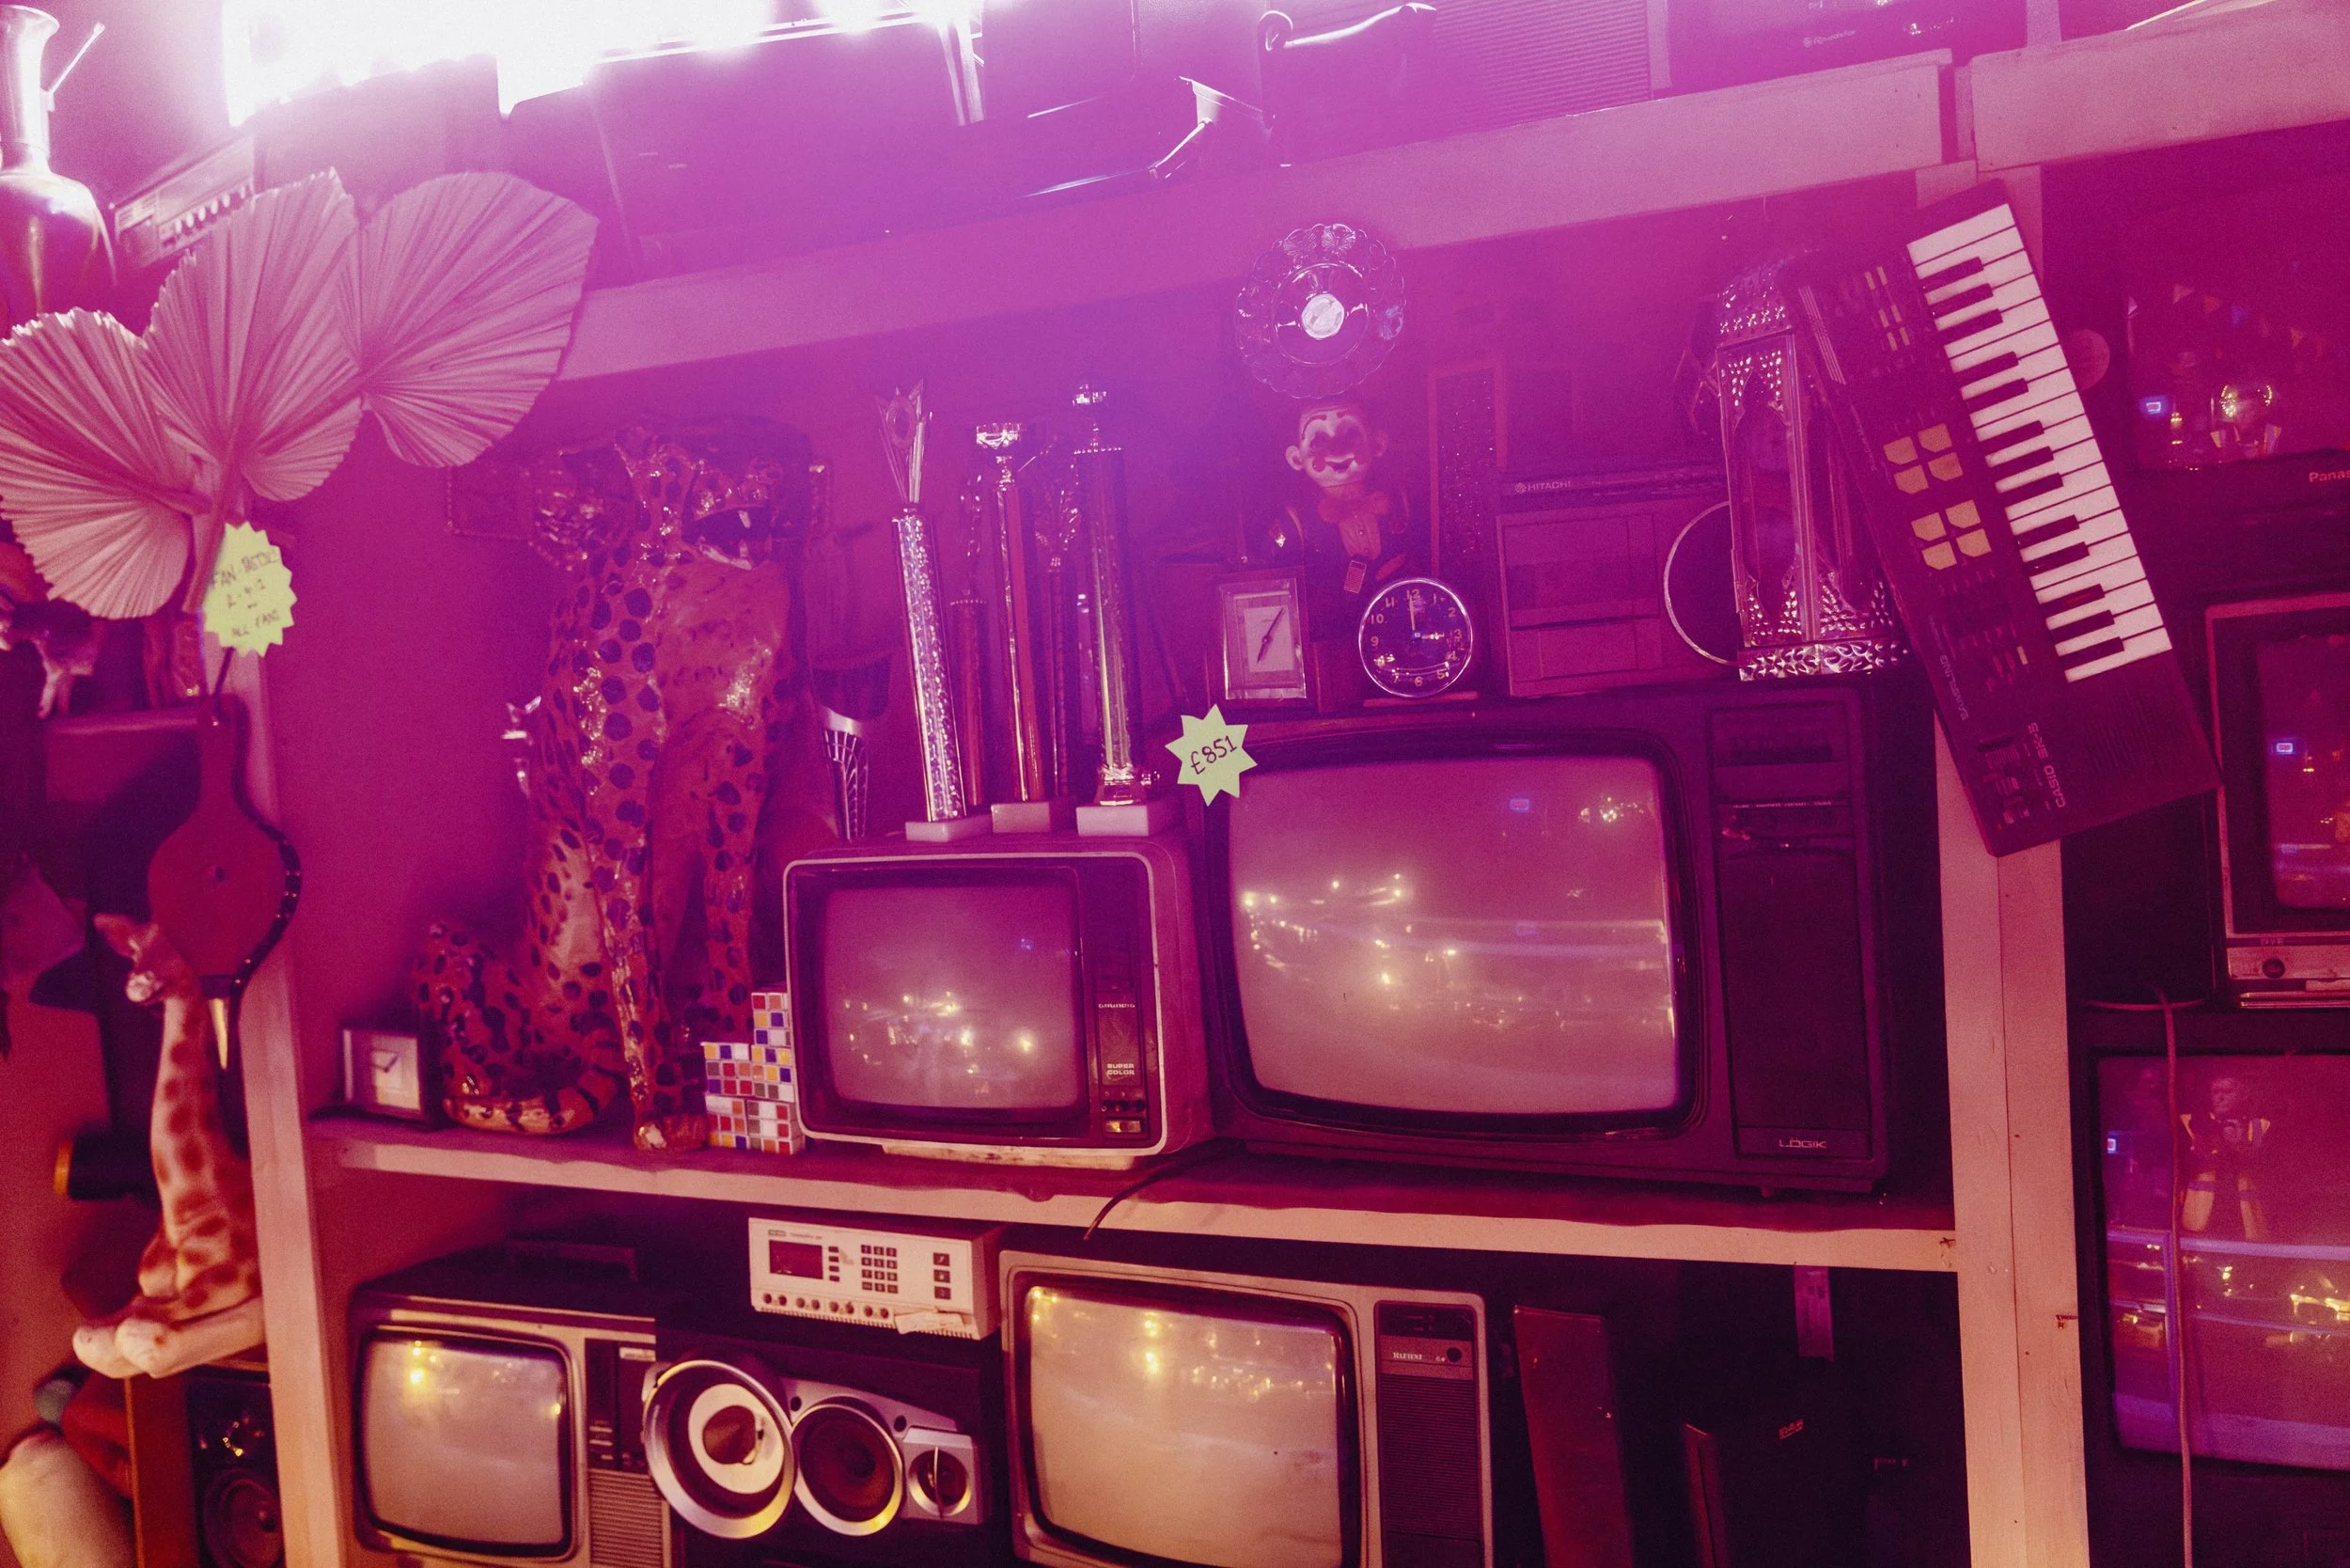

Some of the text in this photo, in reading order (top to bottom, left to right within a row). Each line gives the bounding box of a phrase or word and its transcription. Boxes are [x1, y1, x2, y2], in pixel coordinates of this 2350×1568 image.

[1528, 480, 1571, 491] HITACHI
[1406, 588, 1421, 600] 12
[1449, 607, 1456, 618] 2
[1371, 614, 1384, 624] 10
[1454, 629, 1463, 639] 3
[1371, 636, 1379, 647] 9
[1436, 669, 1446, 680] 5
[1414, 676, 1423, 687] 6
[1940, 655, 1969, 721] SAMPLING
[1190, 735, 1238, 776] £851
[2043, 765, 2066, 808] CASIO
